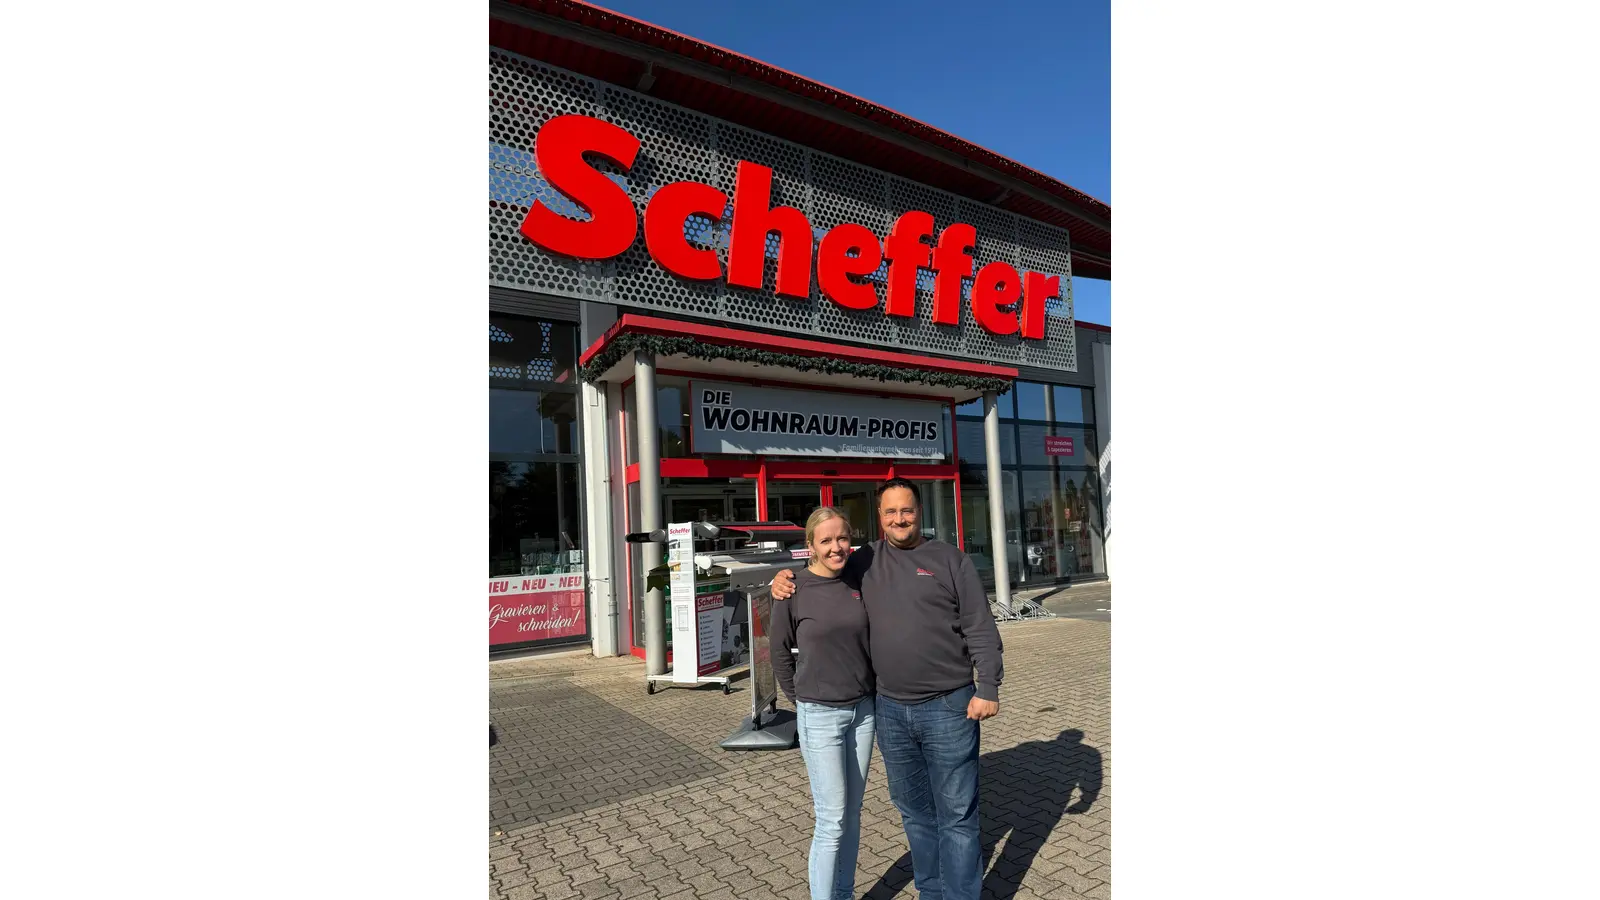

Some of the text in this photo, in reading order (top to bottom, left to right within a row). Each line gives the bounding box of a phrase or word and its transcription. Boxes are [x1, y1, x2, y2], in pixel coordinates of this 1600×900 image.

[520, 114, 1060, 341] Scheffer
[702, 389, 732, 406] DIE
[701, 406, 938, 441] WOHNRAUM-PROFIS
[842, 444, 912, 454] Familienunternehmen
[912, 446, 923, 454] seit
[522, 578, 547, 591] NEU
[559, 576, 582, 588] NEU
[698, 596, 723, 607] Scheffer
[489, 603, 559, 630] Gravieren &
[517, 609, 580, 632] schneiden!
